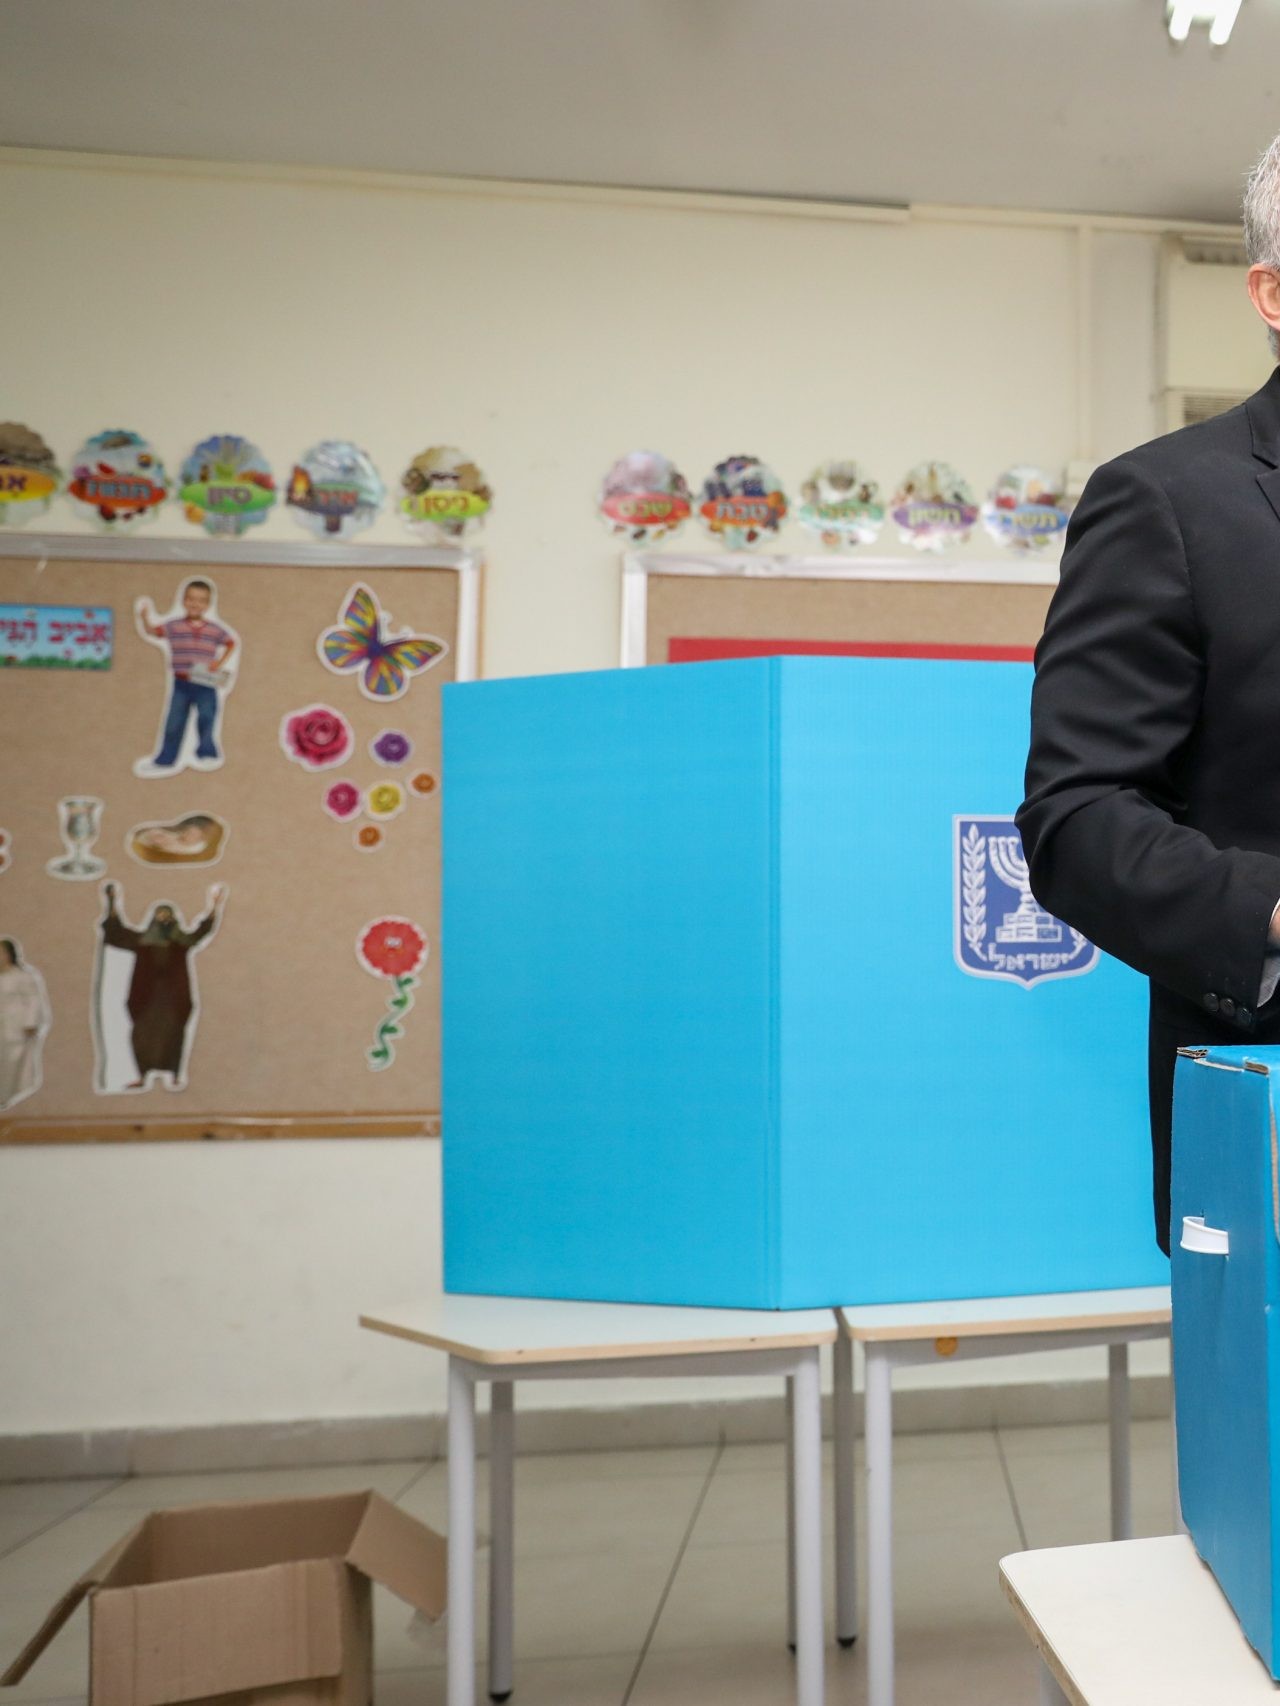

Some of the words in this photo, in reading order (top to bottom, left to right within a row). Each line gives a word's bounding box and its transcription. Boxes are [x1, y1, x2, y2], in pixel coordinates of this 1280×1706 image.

[424, 495, 469, 515] ניסן
[617, 500, 673, 518] שבט
[716, 503, 769, 521] טבת
[987, 942, 1071, 971] ישראל
